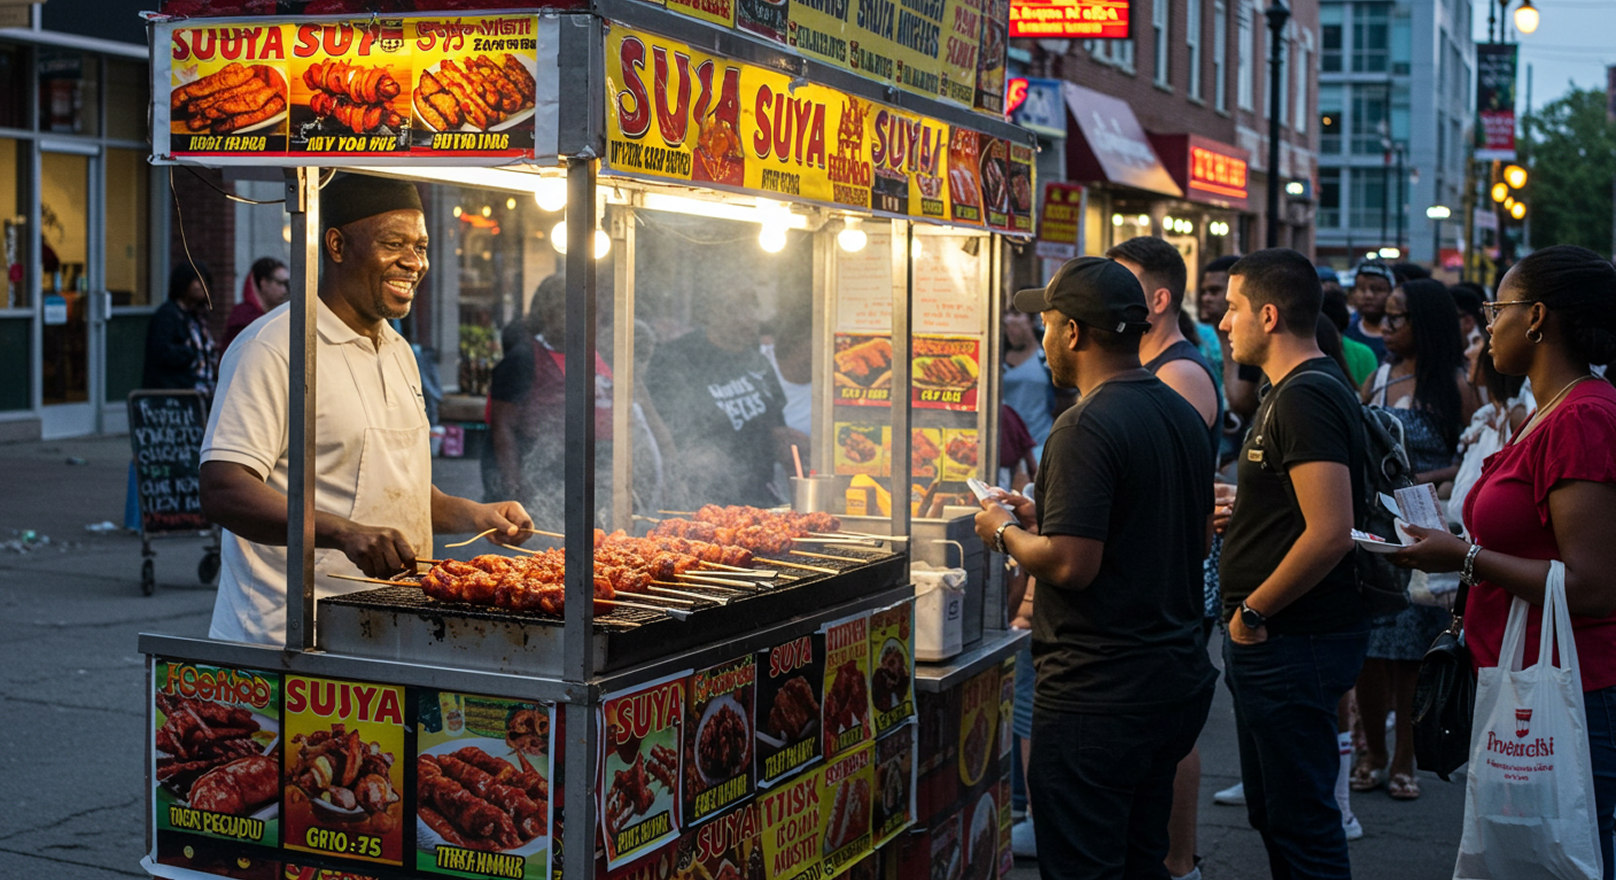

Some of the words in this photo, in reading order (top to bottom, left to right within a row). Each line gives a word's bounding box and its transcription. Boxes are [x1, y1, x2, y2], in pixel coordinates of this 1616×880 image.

[753, 84, 826, 170] SUYA
[769, 635, 812, 679] SUYA
[616, 683, 682, 745] SUYA
[697, 804, 756, 865] SUYA
